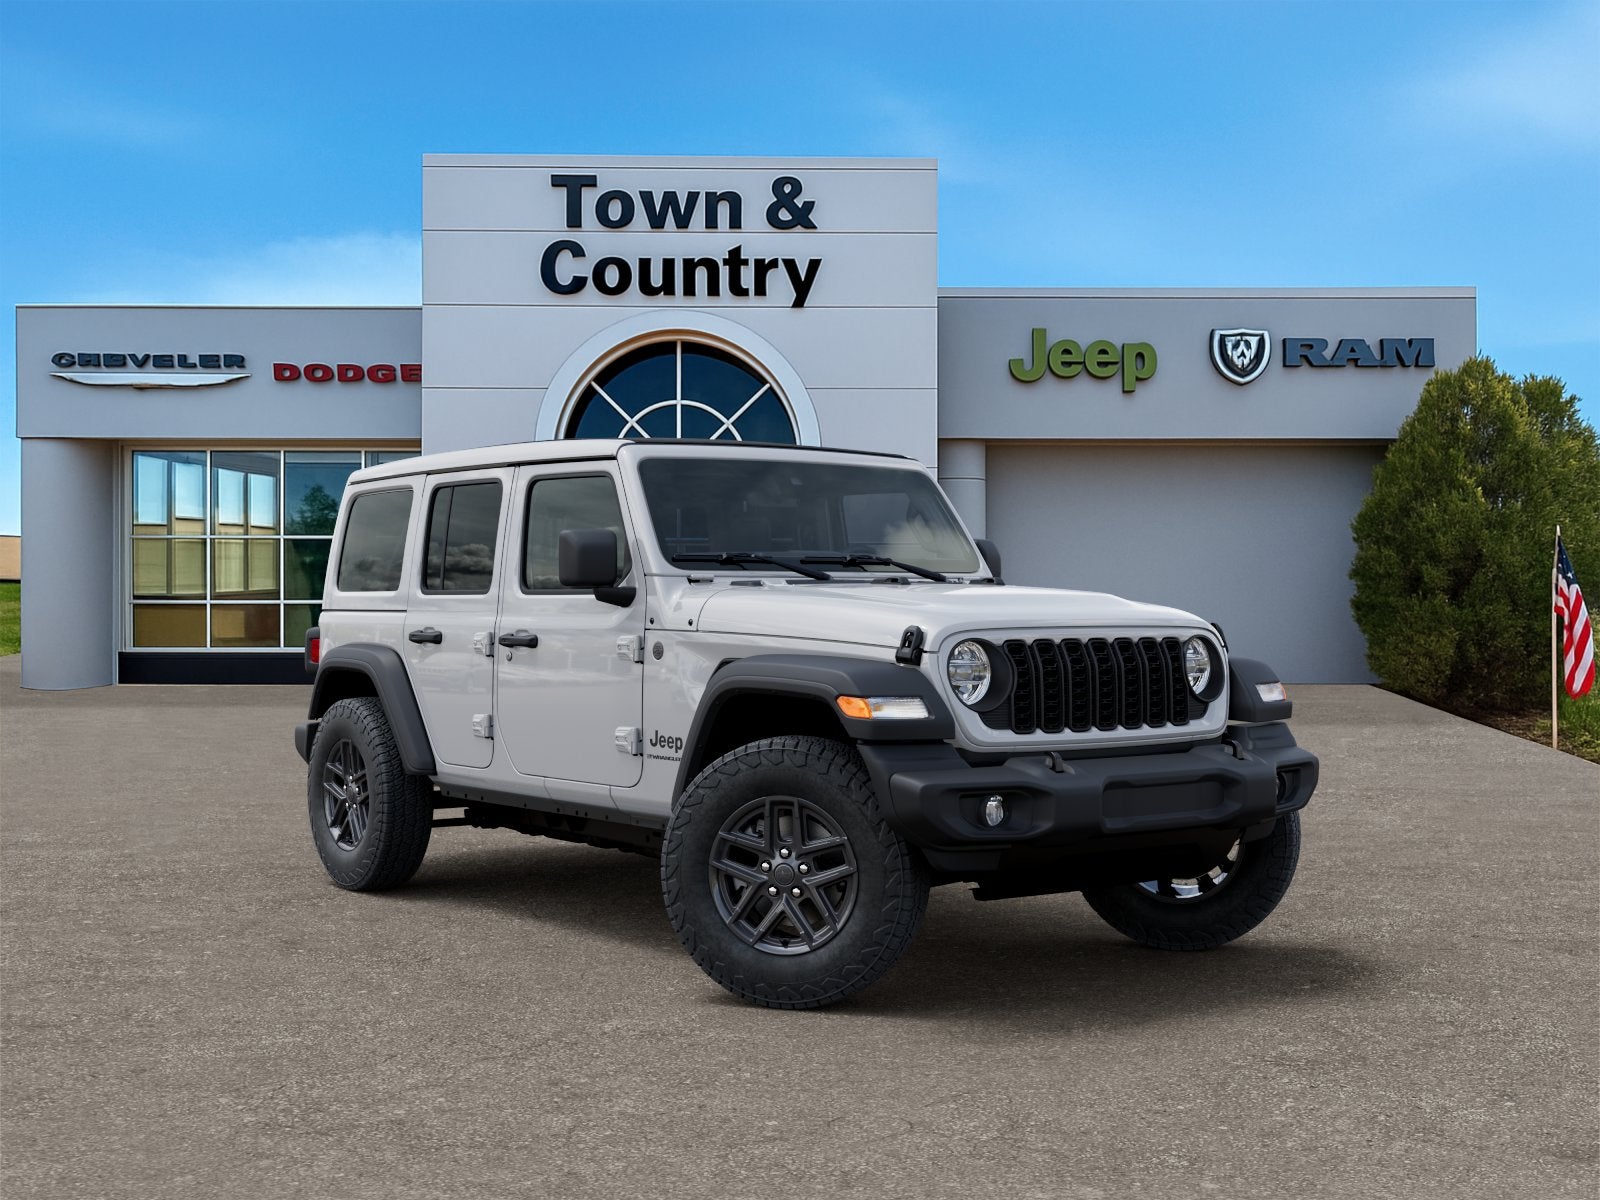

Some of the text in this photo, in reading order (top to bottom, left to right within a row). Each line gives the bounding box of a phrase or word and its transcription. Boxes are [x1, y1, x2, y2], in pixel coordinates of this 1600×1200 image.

[550, 174, 818, 230] Town &
[540, 239, 822, 308] Country
[273, 363, 422, 383] DODGE
[1008, 327, 1158, 393] Jeep
[1282, 337, 1435, 367] RAM
[649, 729, 683, 753] Jeep
